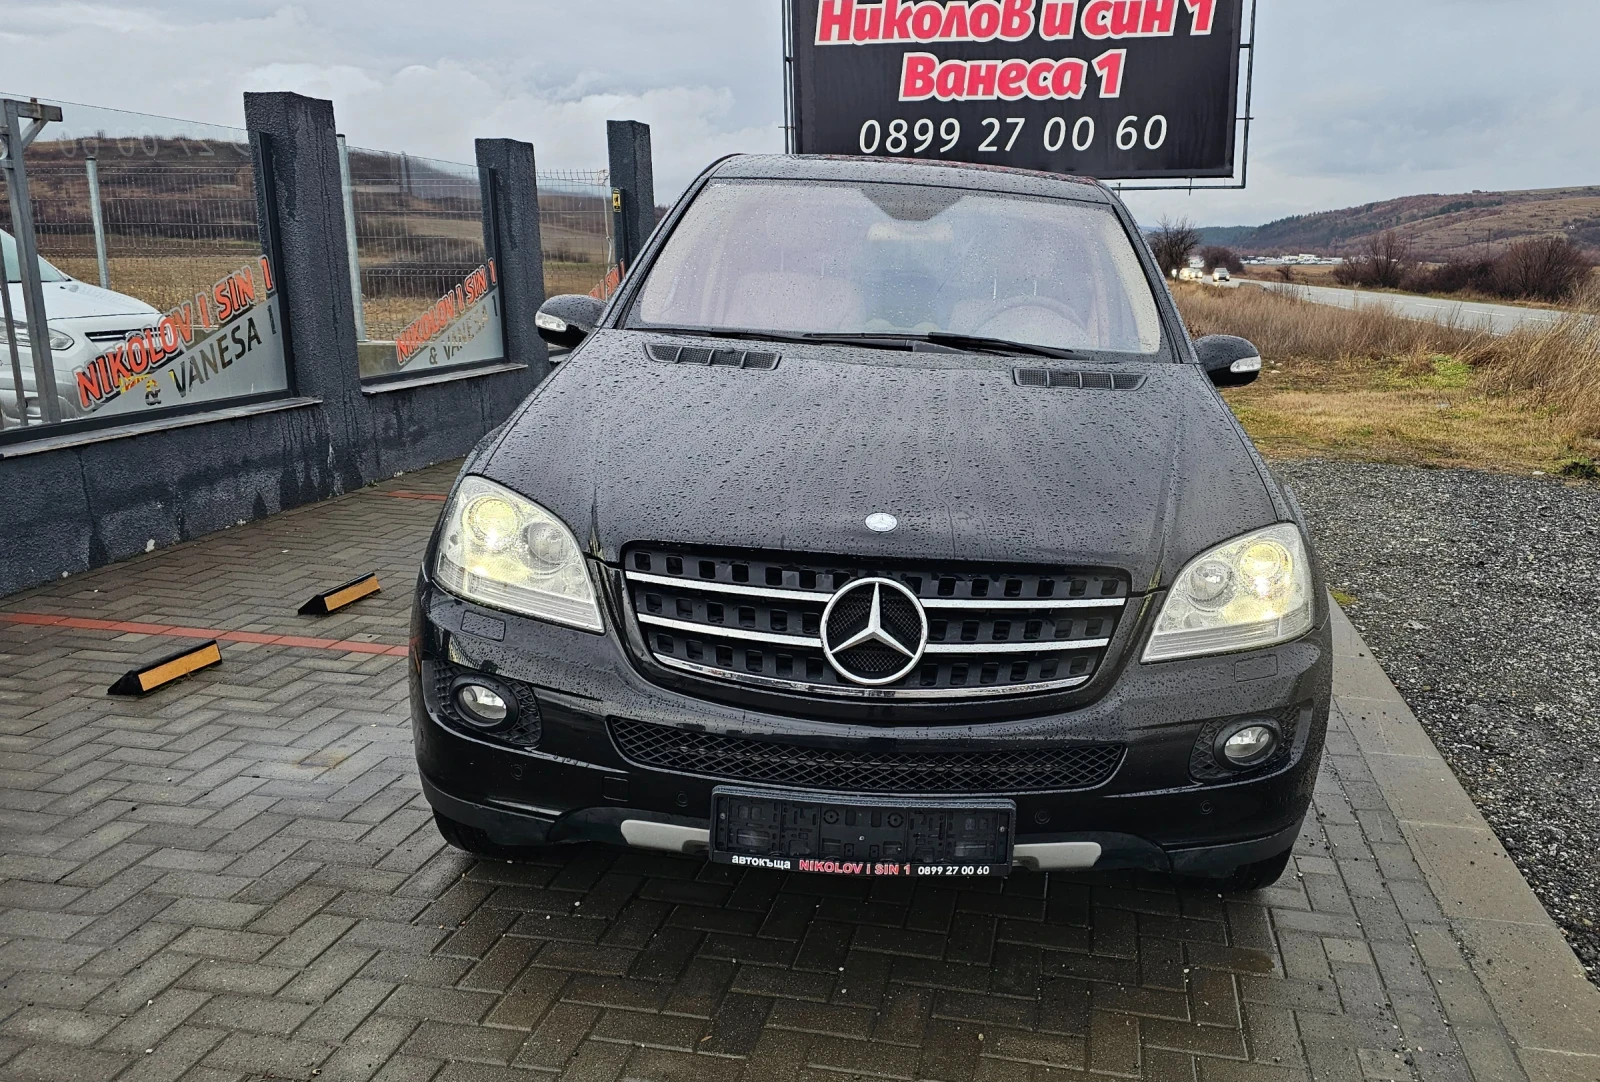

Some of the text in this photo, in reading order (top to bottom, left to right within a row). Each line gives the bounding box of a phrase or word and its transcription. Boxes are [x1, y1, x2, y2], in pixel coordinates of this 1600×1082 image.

[1039, 0, 1077, 41] и
[1081, 0, 1178, 39] син
[1184, 0, 1217, 36] 1
[899, 49, 1126, 101] Ванеса 1
[859, 114, 1168, 153] 0899 27 00 60
[74, 303, 193, 410] NIKOLOV
[196, 292, 212, 332] I
[213, 265, 256, 322] SIN
[396, 290, 455, 365] NIKOLOV
[455, 284, 466, 313] I
[464, 265, 489, 307] SIN
[168, 317, 262, 397] VANESA
[429, 347, 438, 365] &
[732, 855, 791, 870] автокъща
[799, 860, 863, 874] NIKOLOV
[874, 862, 899, 875] SIN
[903, 863, 911, 875] 1
[918, 866, 943, 875] 0899
[946, 866, 959, 875] 27
[961, 866, 974, 875] 00
[977, 866, 990, 875] 60
